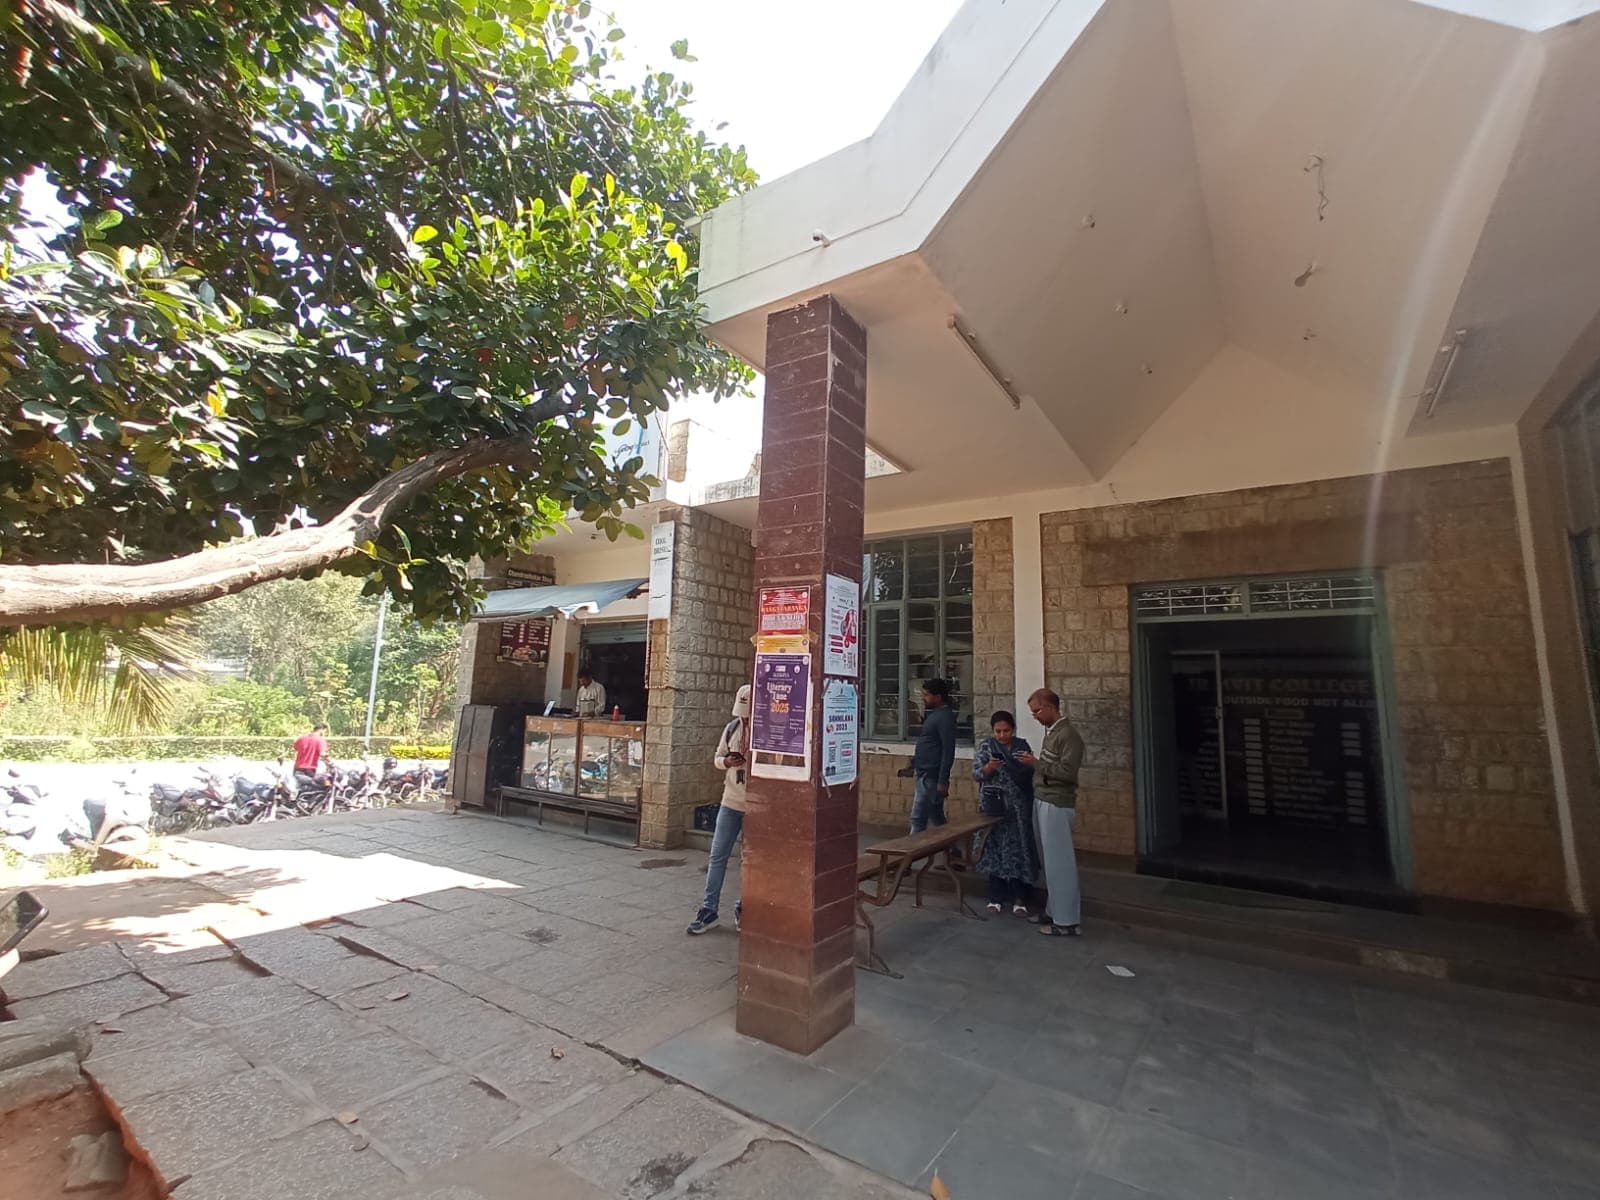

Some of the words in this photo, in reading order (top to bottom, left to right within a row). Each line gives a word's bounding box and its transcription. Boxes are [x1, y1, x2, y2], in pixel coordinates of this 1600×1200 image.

[1270, 678, 1370, 694] COLLEGE
[1223, 695, 1273, 706] OUTSIDE
[770, 702, 789, 713] 2025
